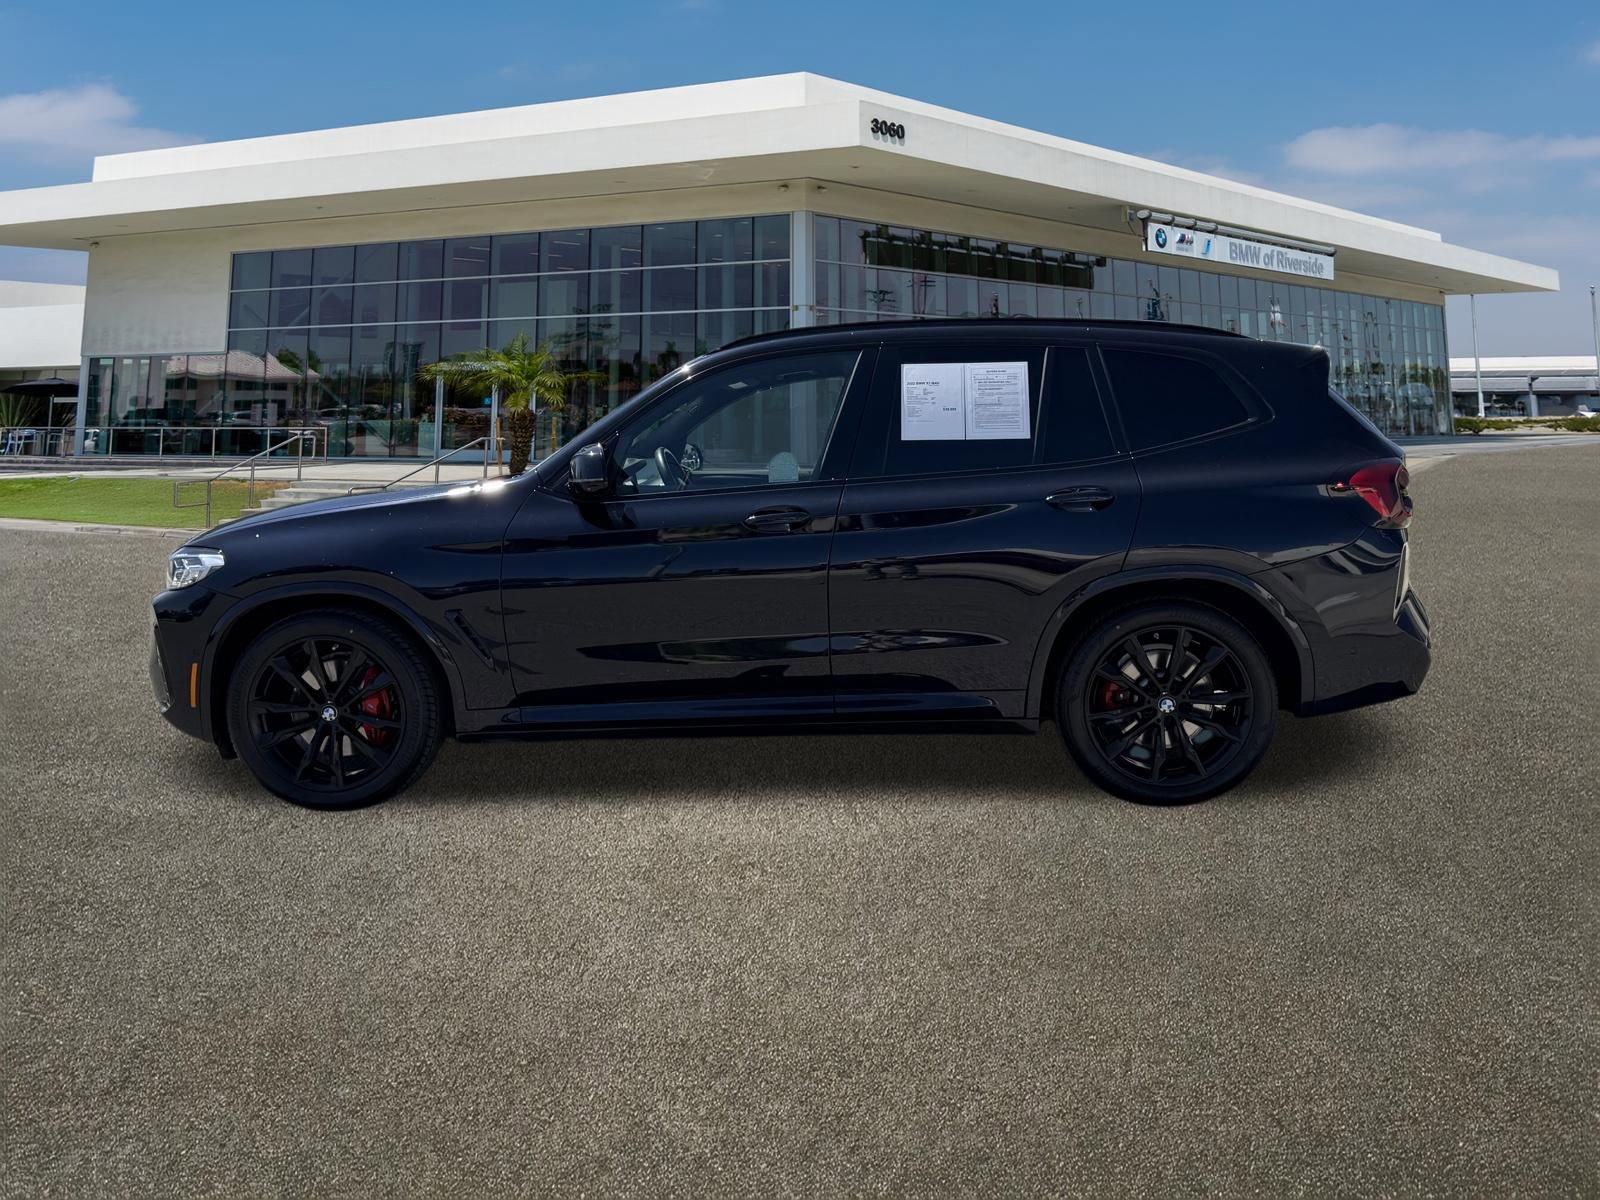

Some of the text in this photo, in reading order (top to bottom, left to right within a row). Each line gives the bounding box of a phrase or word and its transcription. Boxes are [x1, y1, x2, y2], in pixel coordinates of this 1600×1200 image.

[870, 118, 905, 139] 3060
[1229, 242, 1324, 275] BMW of Riverside
